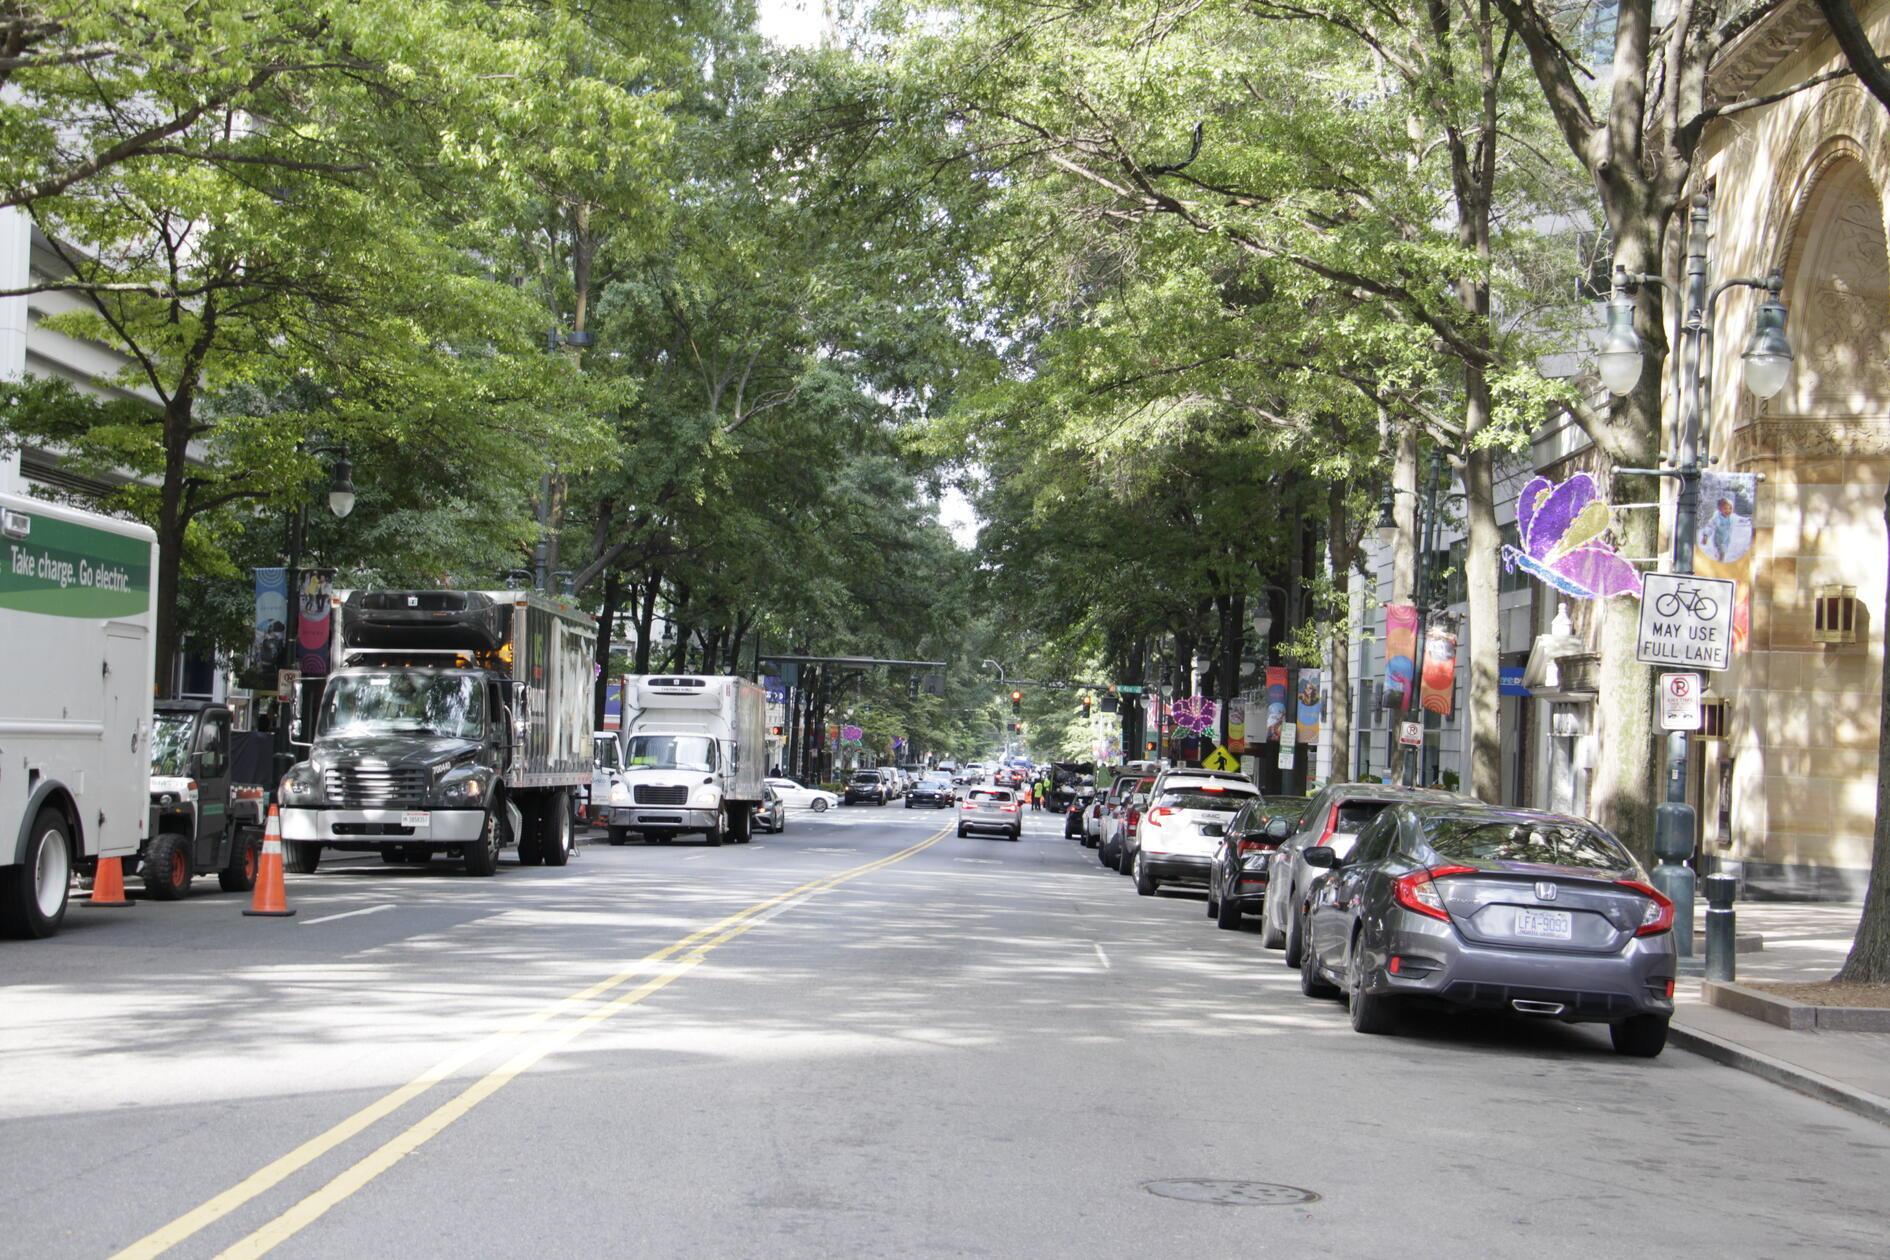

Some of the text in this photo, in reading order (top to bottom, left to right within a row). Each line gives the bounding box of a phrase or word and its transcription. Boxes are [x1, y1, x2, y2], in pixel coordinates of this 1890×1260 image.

[11, 545, 131, 592] Take charge. Go electric.
[1653, 622, 1716, 641] MAY USE
[1644, 641, 1721, 662] FULL LANE
[1519, 914, 1568, 933] LFA-9093
